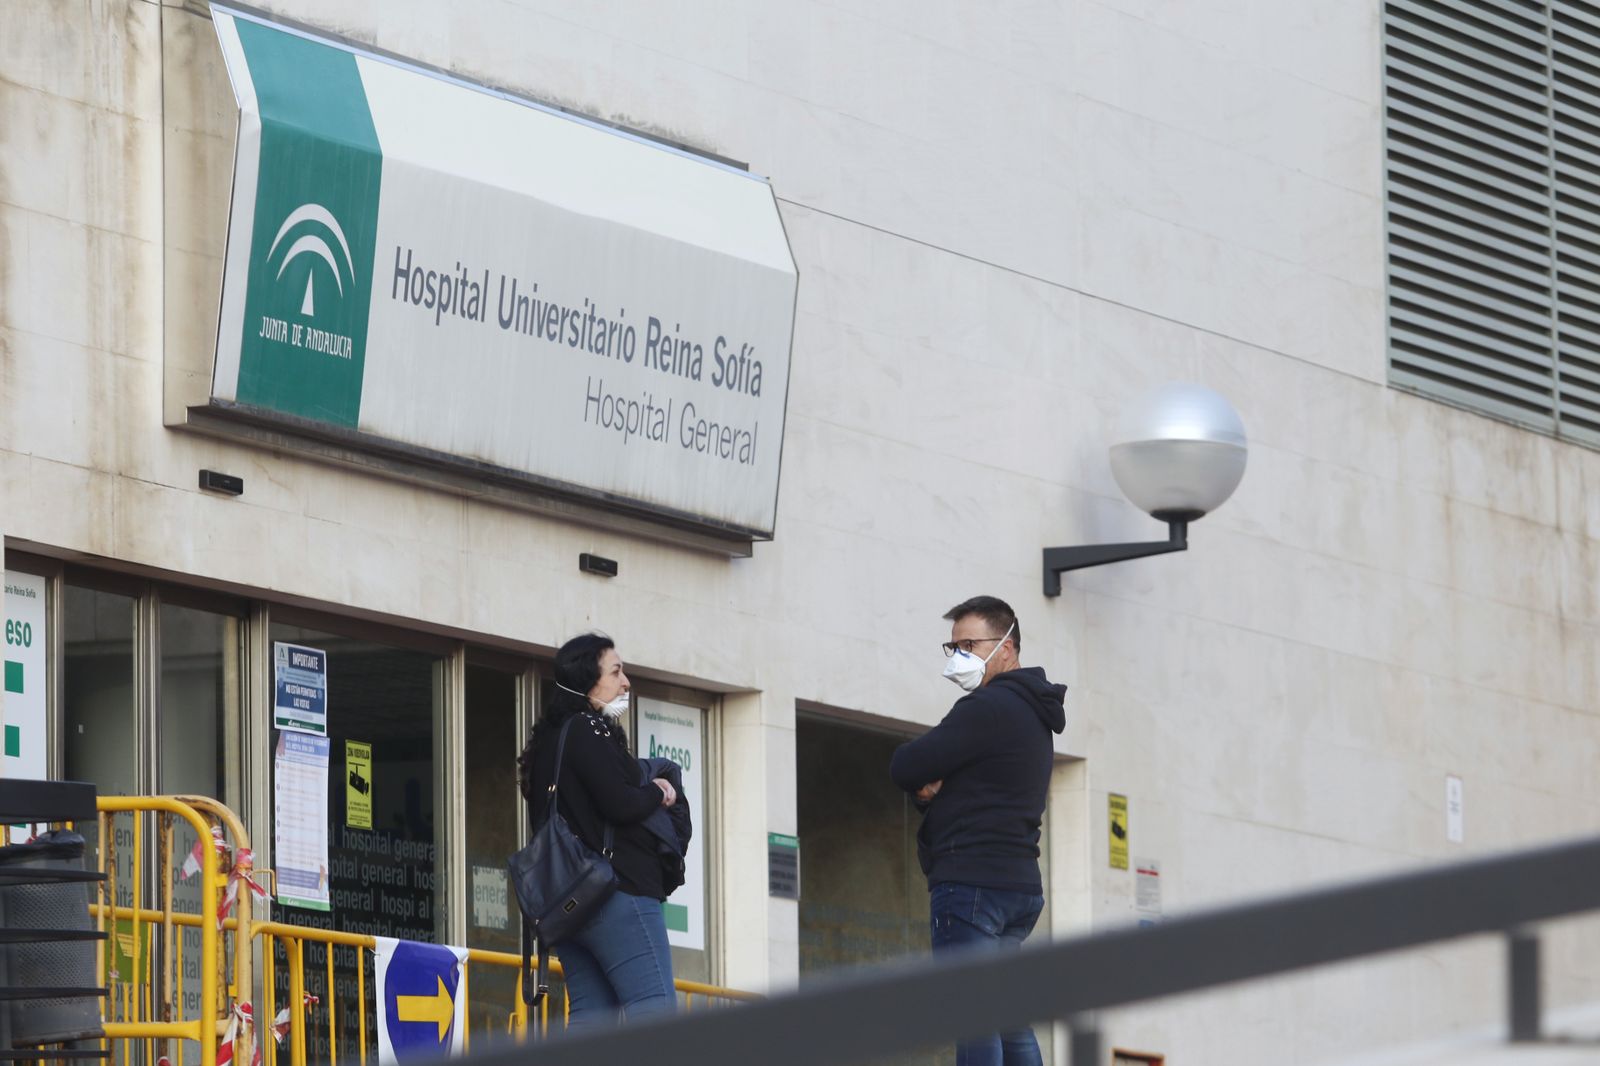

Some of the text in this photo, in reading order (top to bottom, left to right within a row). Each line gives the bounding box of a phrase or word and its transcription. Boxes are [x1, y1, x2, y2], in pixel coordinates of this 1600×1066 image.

[260, 316, 288, 343] JUNTA
[291, 323, 303, 347] DE
[392, 246, 762, 398] Hospital Universitario Reina Sofía
[584, 375, 758, 466] Hospital General
[292, 652, 318, 670] IMPORTANTE
[342, 825, 391, 857] hospital
[394, 838, 437, 862] genera
[361, 861, 407, 887] general
